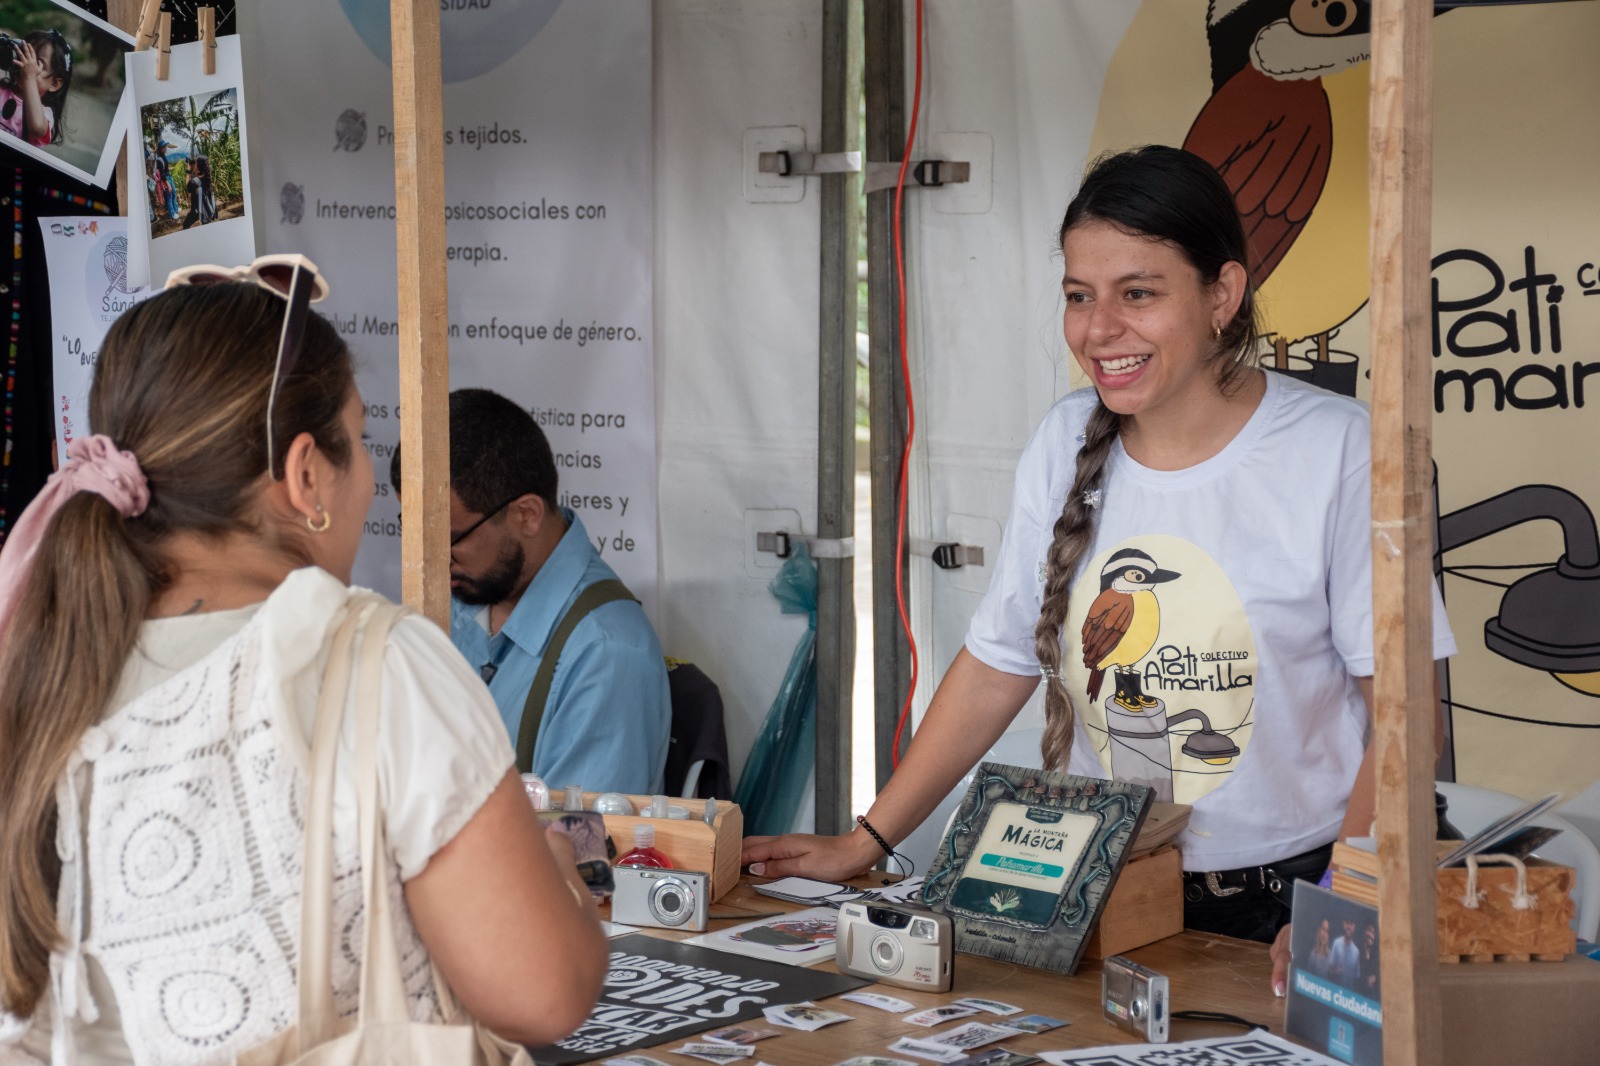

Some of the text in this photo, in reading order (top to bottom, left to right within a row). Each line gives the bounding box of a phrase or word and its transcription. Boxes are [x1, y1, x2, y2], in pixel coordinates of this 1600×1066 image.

[441, 0, 490, 11] SIDAD
[460, 122, 527, 150] tejidos.
[316, 198, 606, 225] Intervenc psicosociales con
[446, 243, 508, 266] erapia.
[102, 295, 136, 312] Sánd
[362, 315, 399, 336] Men
[466, 317, 547, 345] enfoque
[553, 319, 572, 339] de
[578, 320, 642, 346] género.
[581, 413, 625, 433] para
[555, 450, 602, 469] ncias
[619, 497, 629, 516] y
[613, 530, 635, 551] de
[1157, 644, 1249, 676] Pati COLECTIVO
[1143, 661, 1252, 692] Amarilla
[1000, 824, 1065, 852] MÁGICA
[603, 965, 768, 1018] OLDES
[1297, 973, 1382, 1024] Nuevas ciudadan
